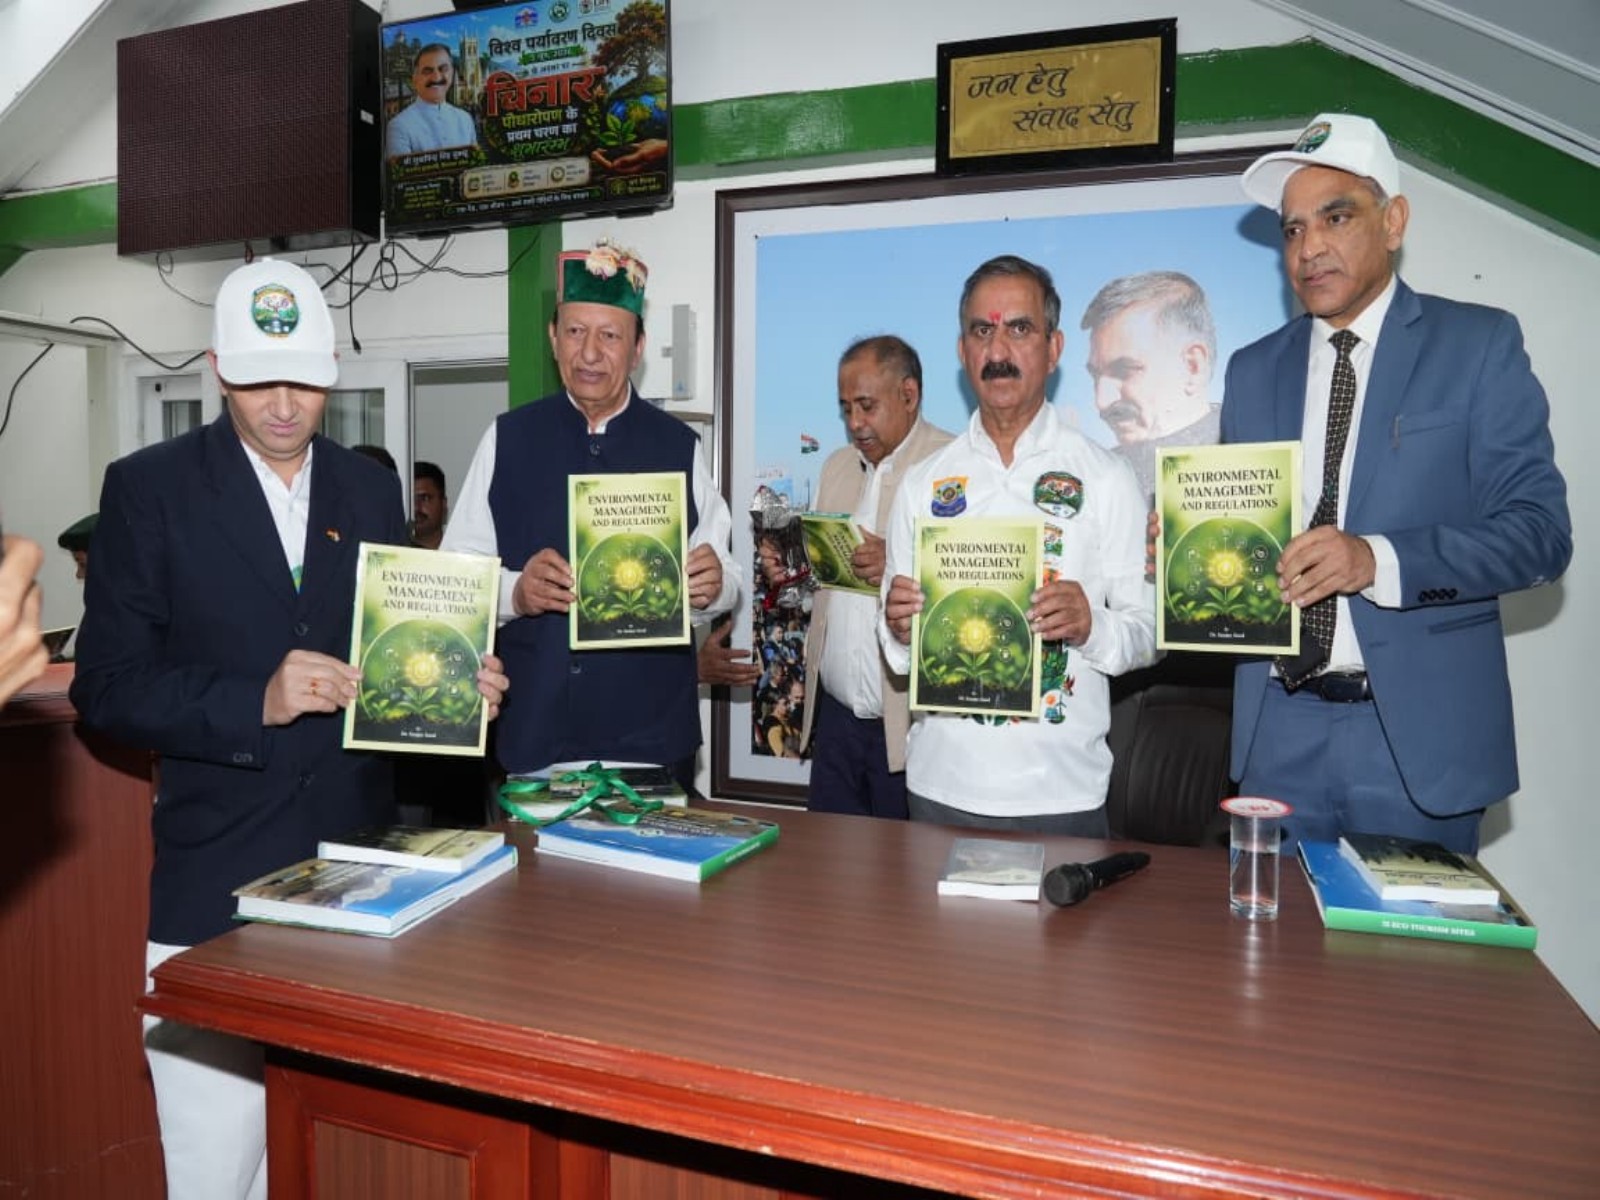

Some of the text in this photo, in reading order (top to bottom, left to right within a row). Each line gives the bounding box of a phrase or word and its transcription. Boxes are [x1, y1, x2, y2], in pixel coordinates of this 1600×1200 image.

[489, 38, 522, 57] विश्व
[525, 29, 578, 51] पर्यावरण
[581, 22, 617, 40] दिवस
[968, 63, 1074, 98] जन हेतु
[486, 66, 607, 117] चिनार
[1013, 96, 1139, 133] संवाद सेतु
[1178, 468, 1282, 484] ENVIRONMENTAL
[588, 492, 674, 505] ENVIRONMENTAL
[1184, 483, 1274, 499] MANAGEMENT
[594, 505, 667, 517] MANAGEMENT
[1180, 499, 1278, 511] AND REGULATIONS
[591, 516, 671, 527] AND REGULATIONS
[935, 542, 1028, 554] ENVIRONMENTAL
[940, 557, 1021, 568] MANAGEMENT
[381, 570, 483, 590] ENVIRONMENTAL
[936, 571, 1024, 581] AND REGULATIONS
[387, 584, 476, 604] MANAGEMENT
[382, 599, 478, 616] AND REGULATIONS
